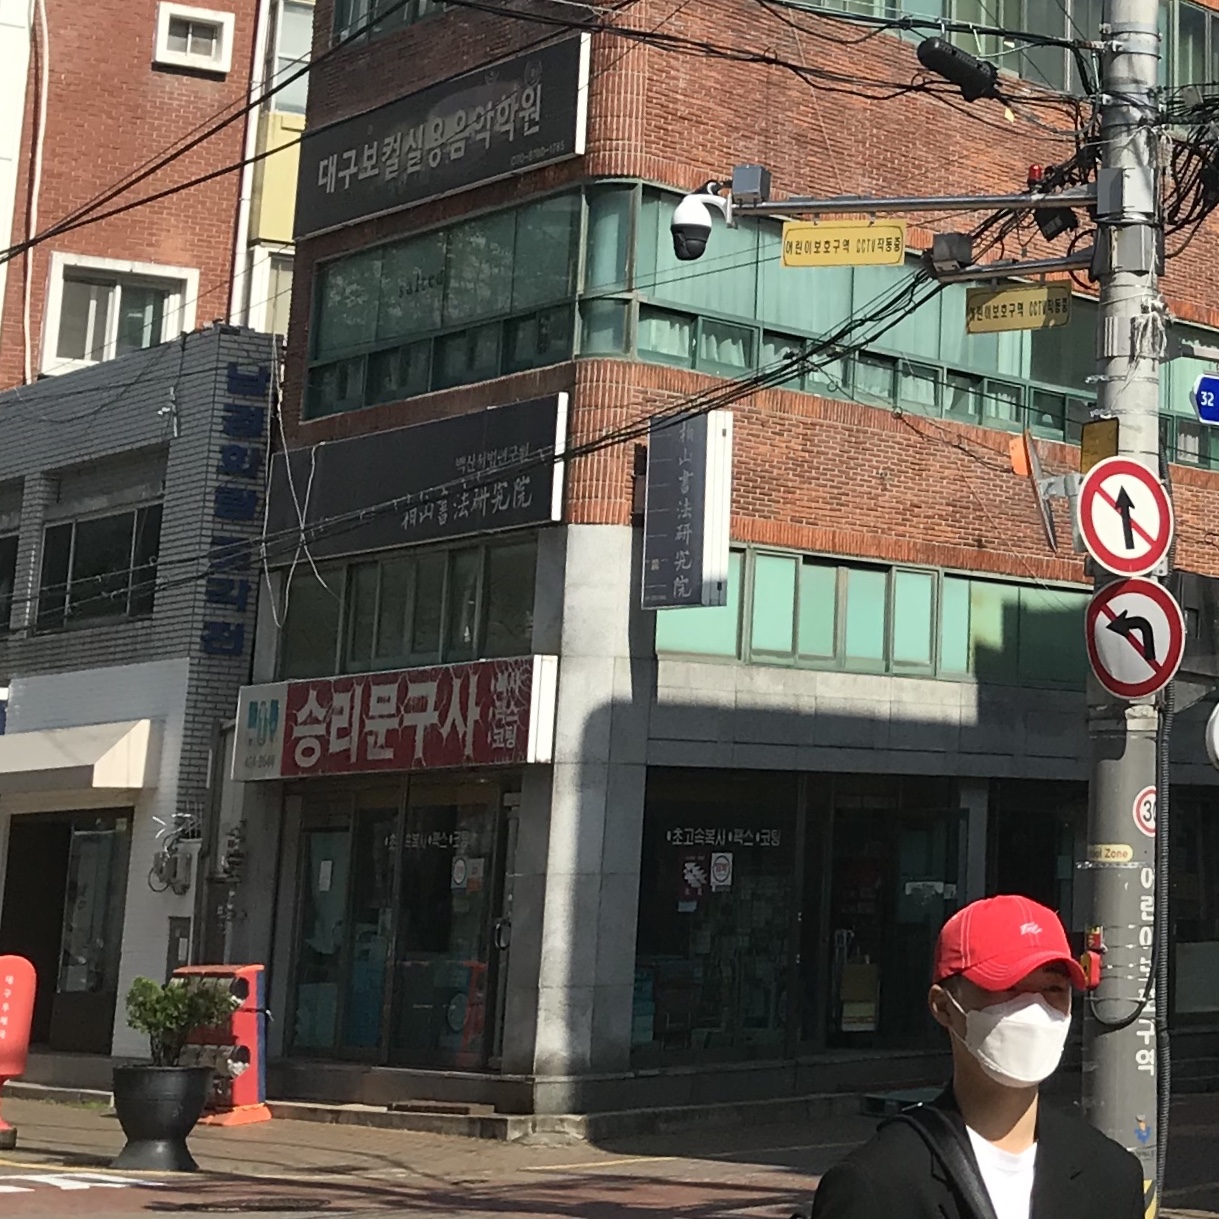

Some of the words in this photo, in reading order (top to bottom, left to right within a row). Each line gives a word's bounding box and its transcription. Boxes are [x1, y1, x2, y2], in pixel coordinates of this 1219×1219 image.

[317, 83, 542, 194] 대구보컬실용음악학원
[785, 238, 850, 256] 어린이보호구역
[856, 236, 902, 254] CCTV작동중
[968, 299, 1024, 323] 어린이보호구역
[1201, 391, 1215, 407] 32
[291, 670, 480, 768] 승리문구사
[1104, 848, 1128, 859] Zone
